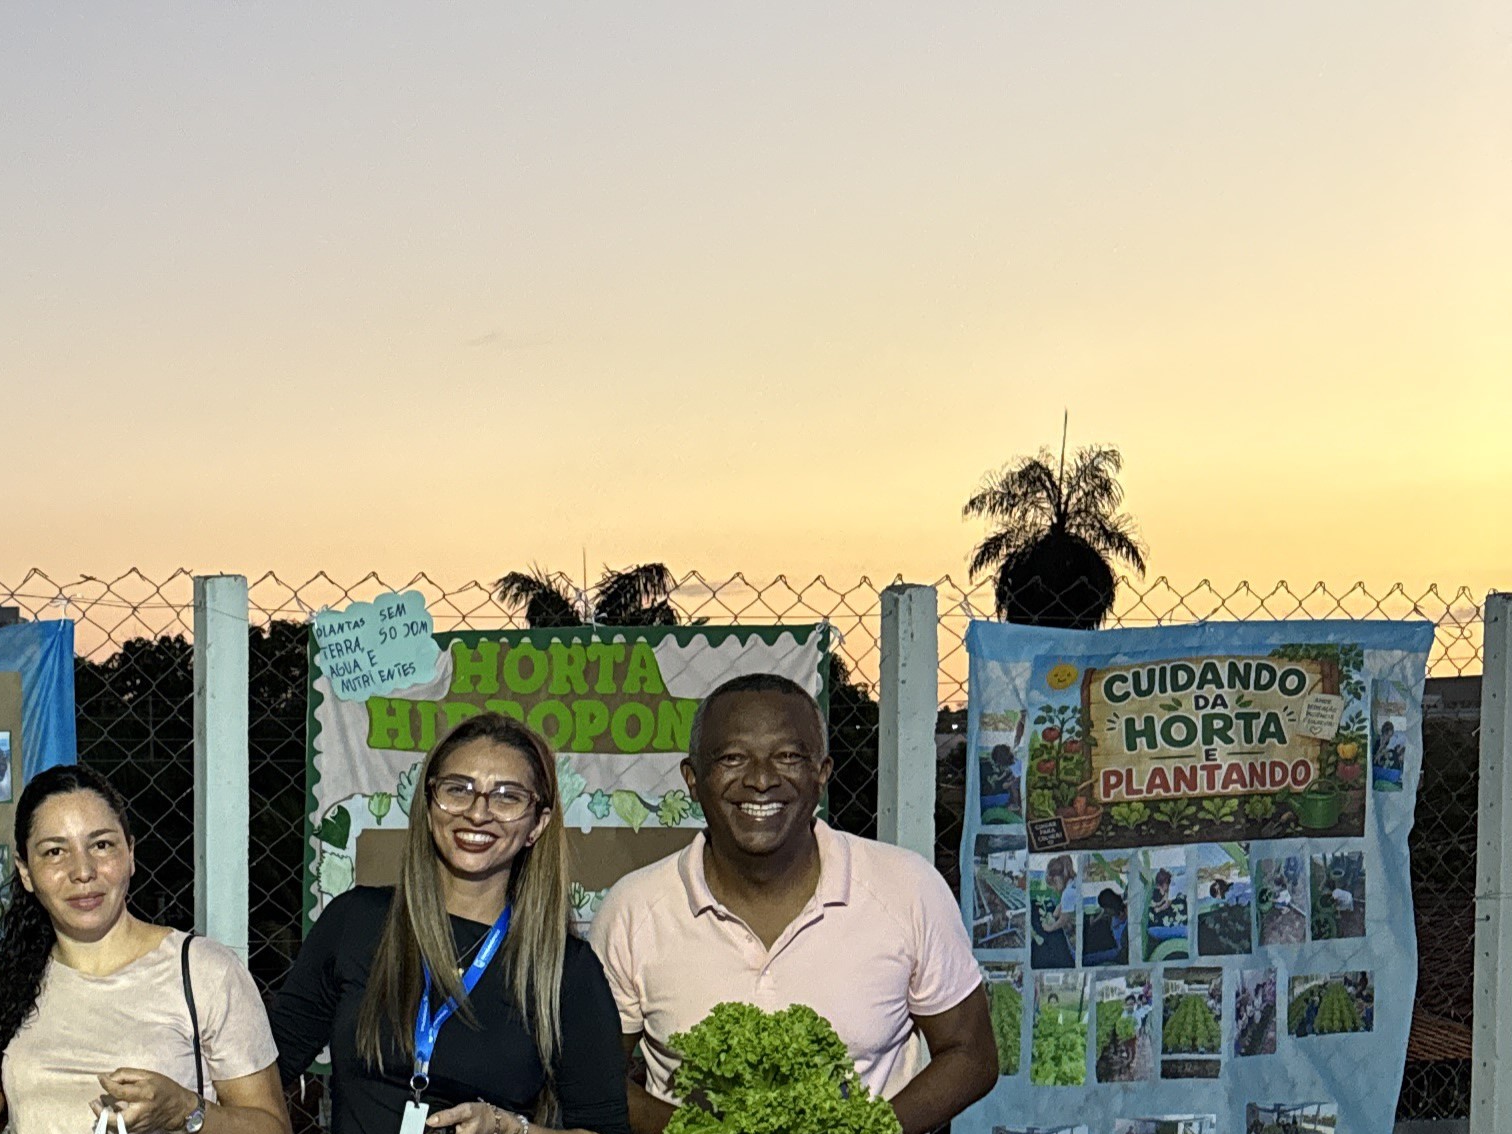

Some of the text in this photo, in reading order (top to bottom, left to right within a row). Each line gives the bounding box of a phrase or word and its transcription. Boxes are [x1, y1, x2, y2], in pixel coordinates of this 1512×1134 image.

[316, 603, 406, 639] PLANTAS SEM
[330, 650, 378, 678] AGUA E
[451, 641, 664, 695] HORTA
[1103, 661, 1307, 703] CUIDANDO
[1194, 694, 1228, 711] DA
[1124, 712, 1287, 751] HORTA
[1204, 748, 1218, 761] E
[1102, 759, 1312, 798] PLANTANDO
